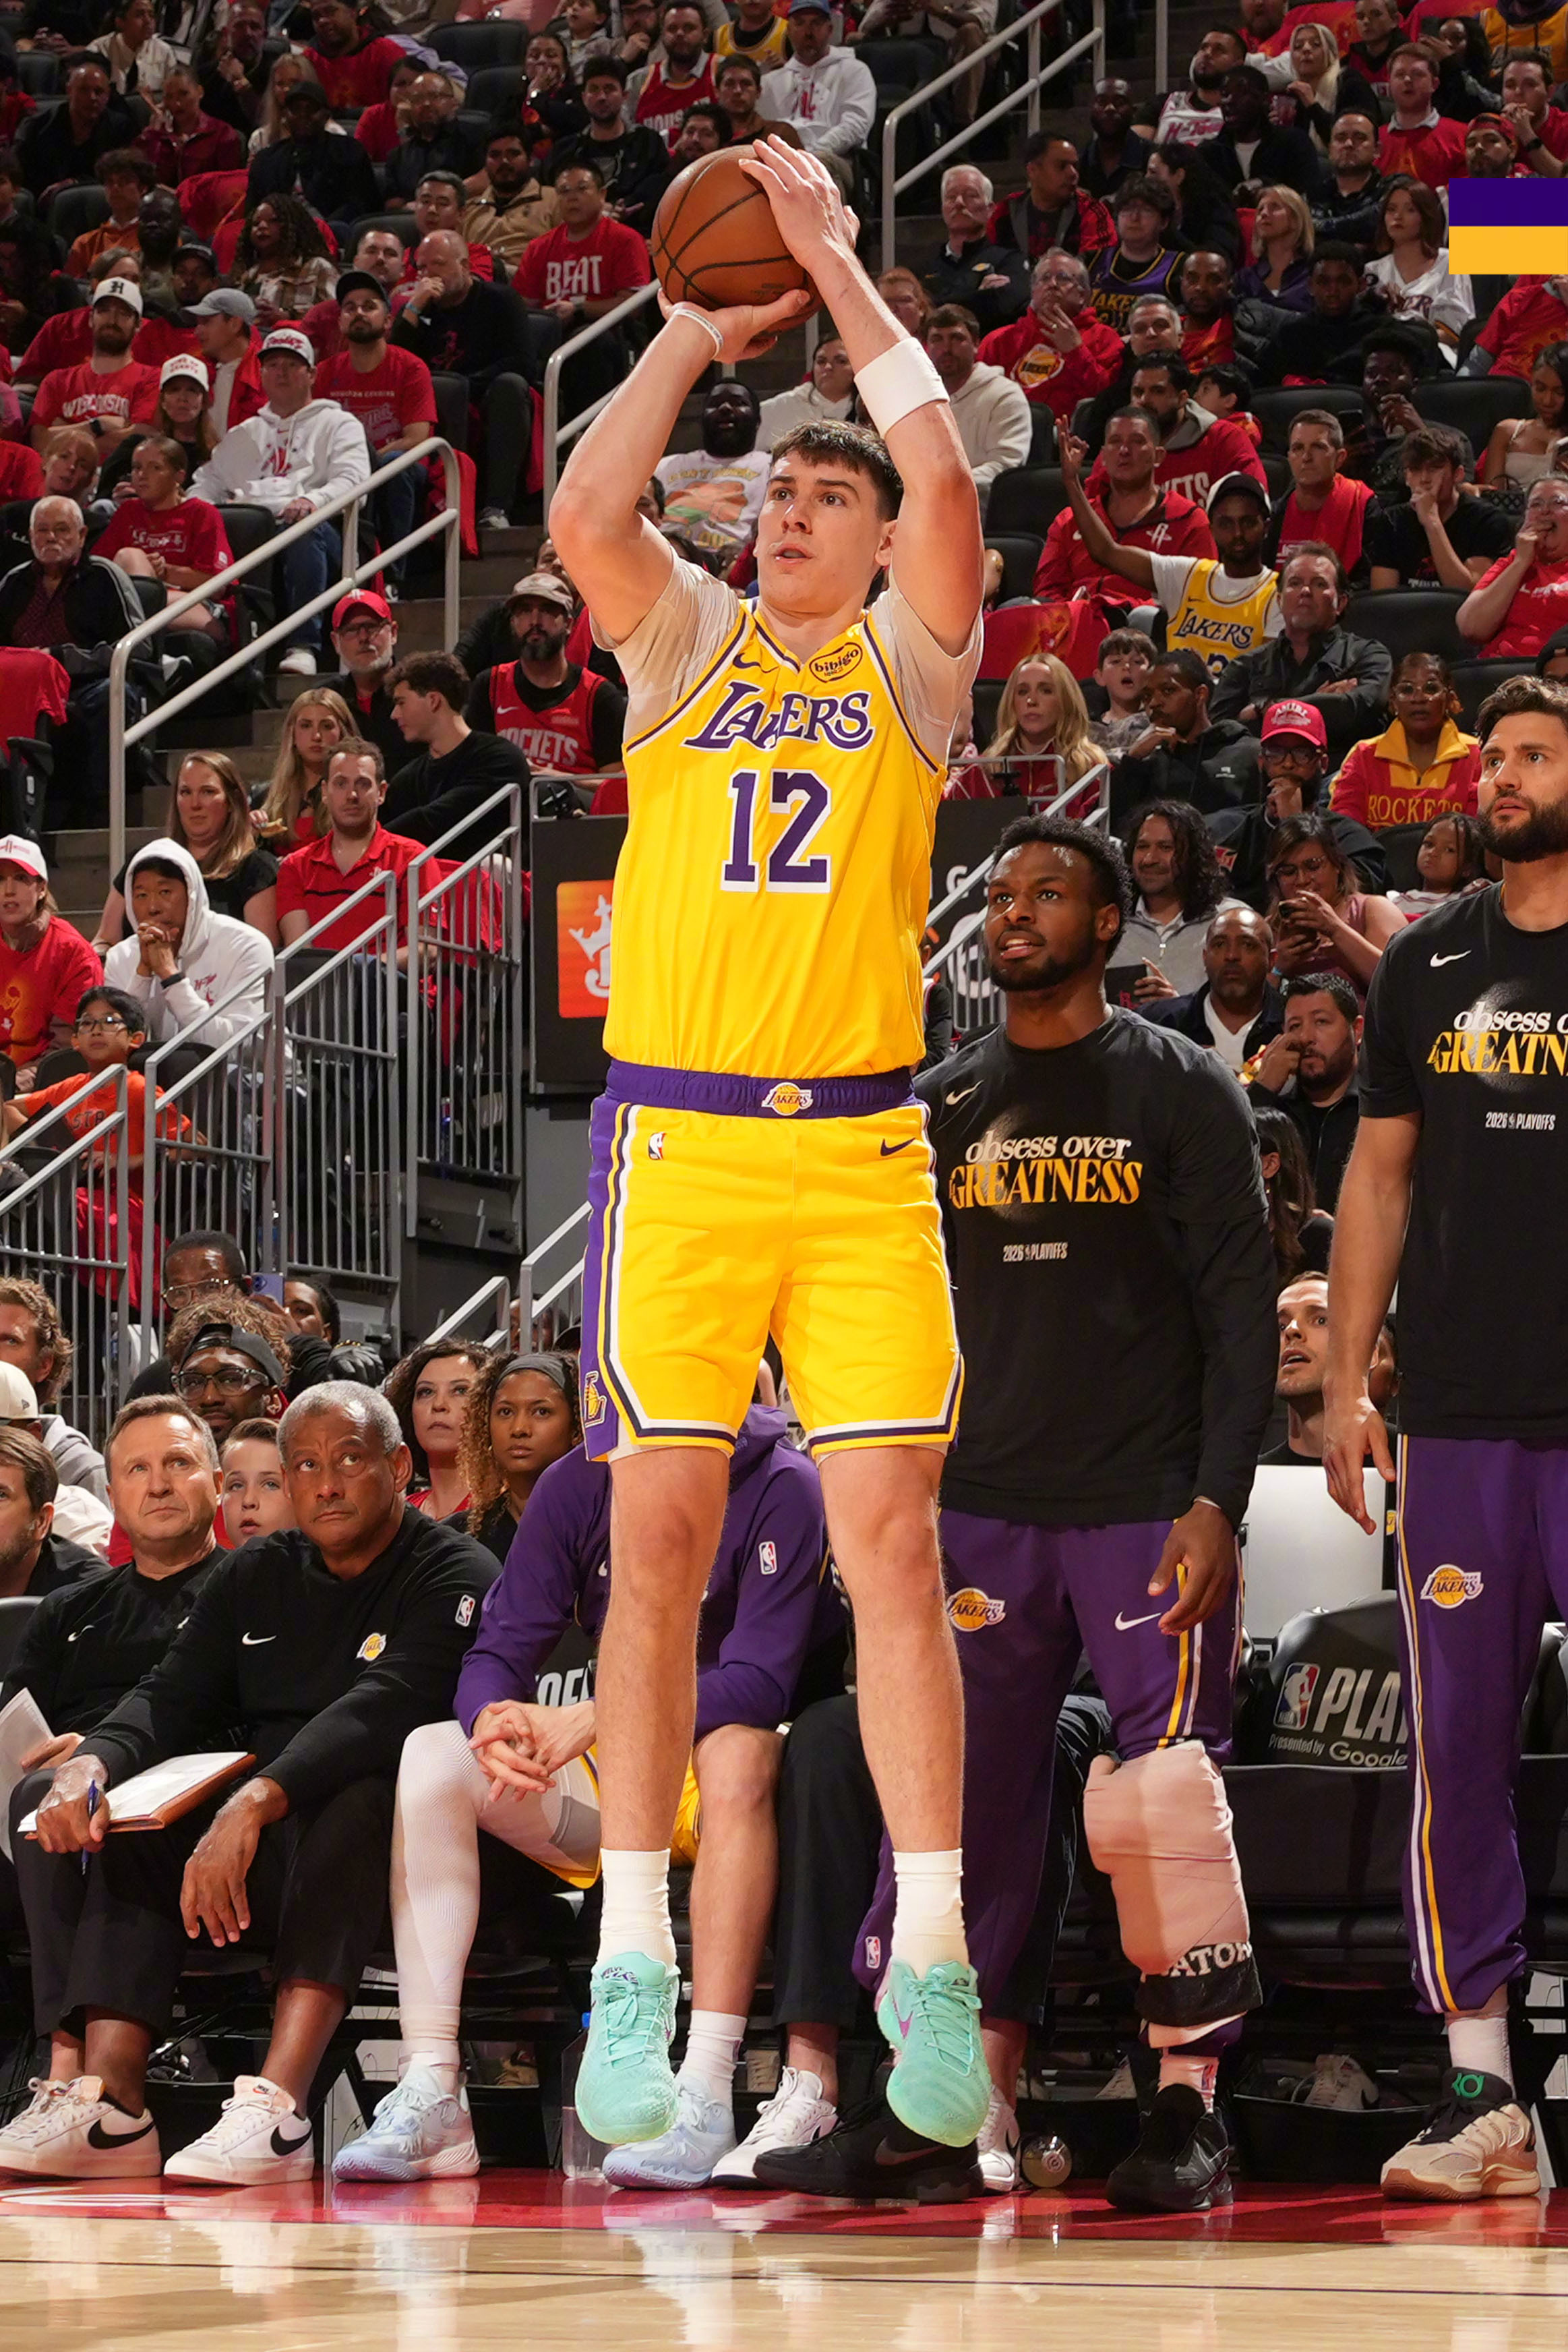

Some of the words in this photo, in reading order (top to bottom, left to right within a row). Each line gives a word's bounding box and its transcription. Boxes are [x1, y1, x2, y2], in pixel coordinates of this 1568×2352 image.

[545, 256, 603, 299] BEAT
[1174, 608, 1254, 649] LAKERS
[814, 649, 859, 672] bibigo
[497, 727, 579, 766] OCKETS
[720, 768, 831, 893] 12
[1453, 1001, 1552, 1033] obsess
[1426, 1031, 1568, 1077] GREATN
[762, 1088, 813, 1109] LAKERS
[1486, 1112, 1509, 1128] 2026
[1517, 1114, 1557, 1131] PLAYOFFS
[965, 1130, 1058, 1163] obsess
[1062, 1136, 1132, 1160] over
[949, 1158, 1143, 1209] GREATNESS
[1031, 1241, 1068, 1261] PLAYOFFS
[1420, 1573, 1484, 1599] LAKERS
[946, 1597, 1006, 1625] LAKERS
[1269, 1734, 1313, 1754] Presented
[1313, 1738, 1325, 1757] by
[1329, 1741, 1408, 1768] Google
